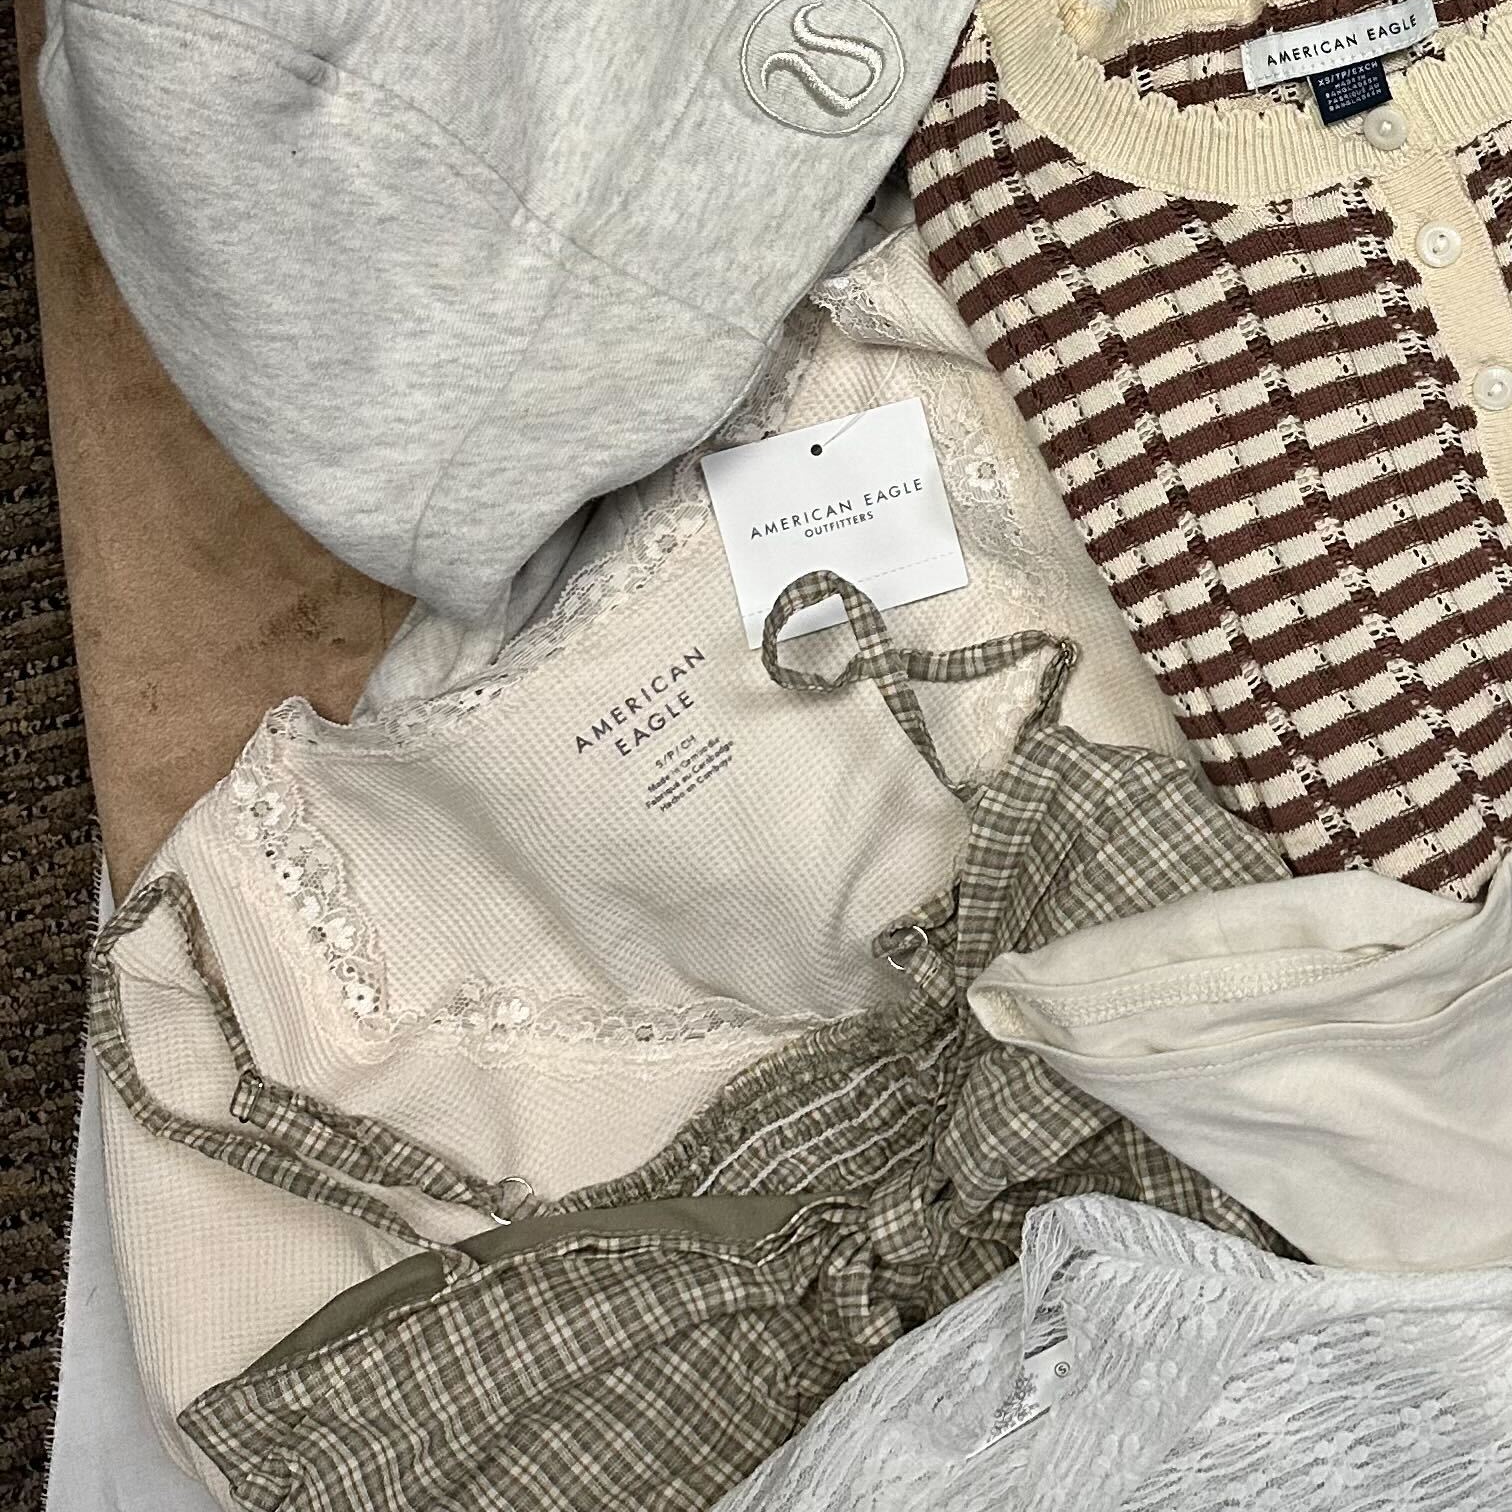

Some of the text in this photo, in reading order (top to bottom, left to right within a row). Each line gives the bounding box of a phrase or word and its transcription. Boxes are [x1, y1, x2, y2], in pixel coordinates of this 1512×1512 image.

[1266, 13, 1418, 68] AMERICAN EAGLE
[750, 477, 924, 540] AMERICAN EAGLE
[803, 510, 874, 539] OUTFITTERS
[575, 646, 706, 754] AMERICAN
[614, 690, 695, 757] EAGLE
[647, 774, 670, 792] Made
